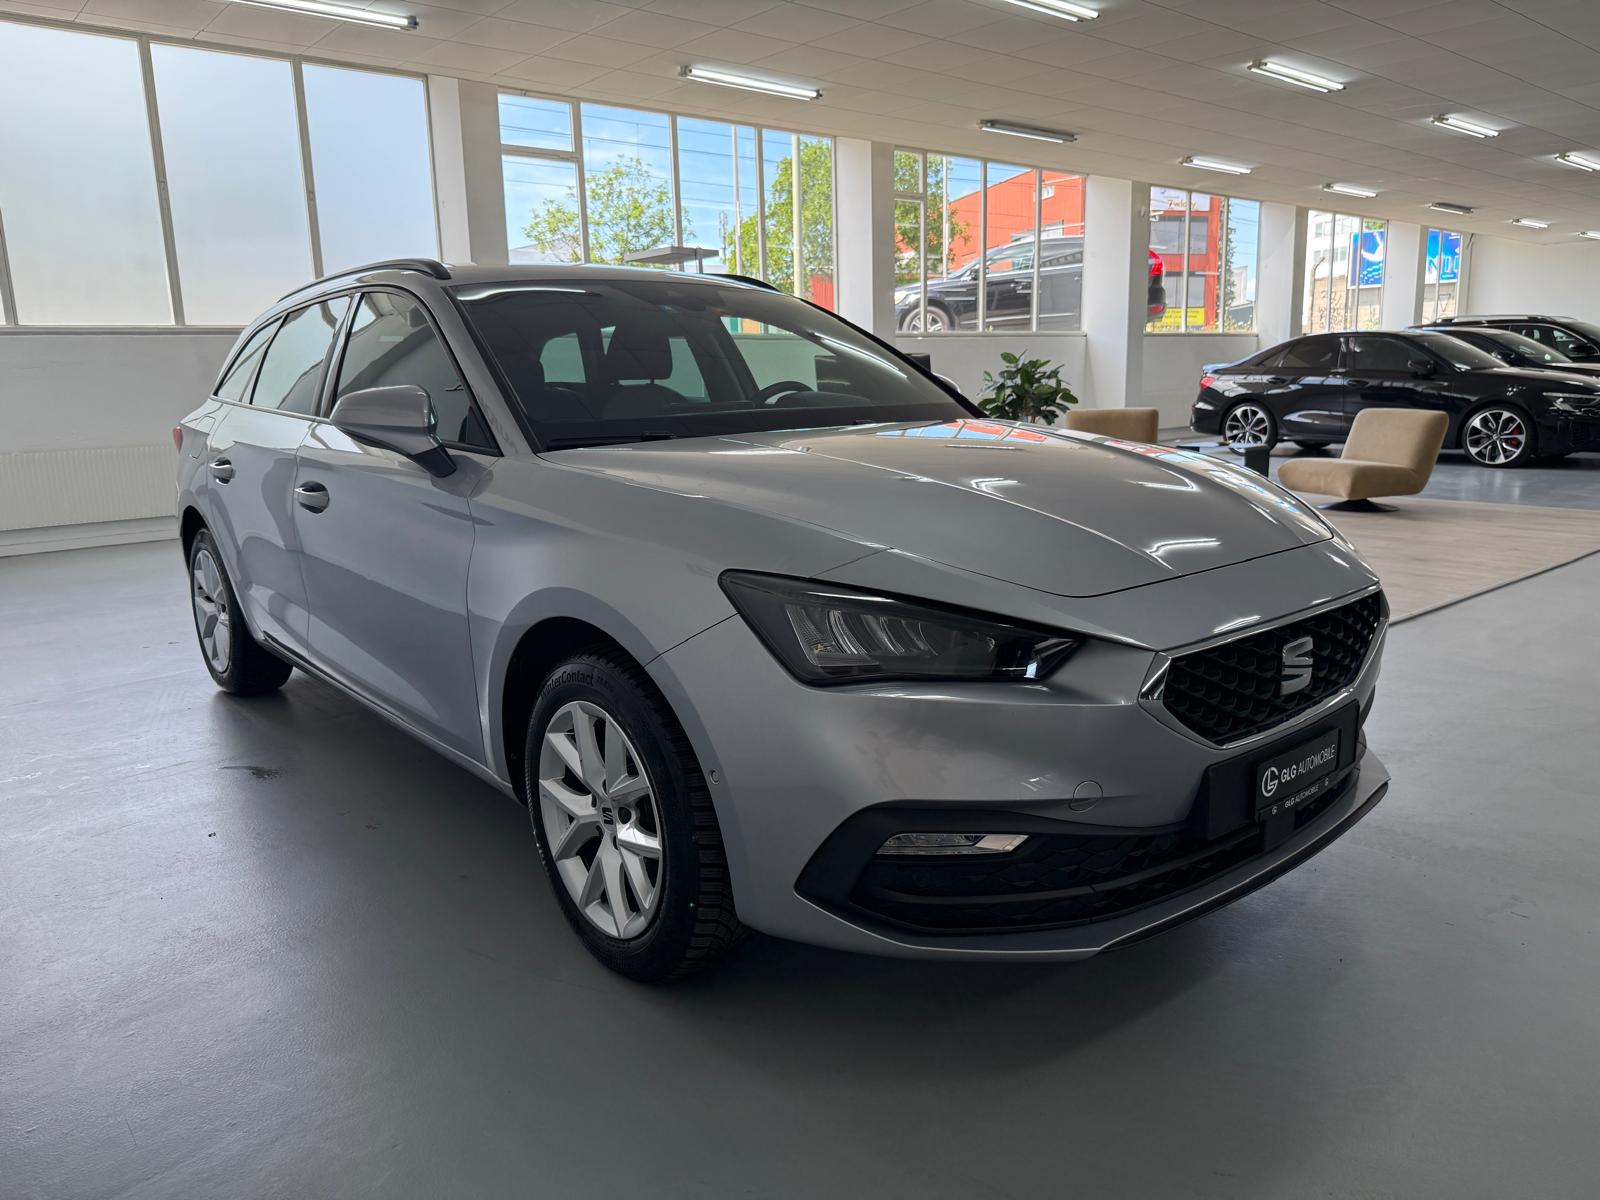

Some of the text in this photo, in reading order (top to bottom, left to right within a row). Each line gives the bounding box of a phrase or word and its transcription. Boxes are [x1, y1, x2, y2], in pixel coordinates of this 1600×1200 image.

[1281, 764, 1297, 783] GLG
[1297, 744, 1336, 776] AUTOMOBILE
[1284, 797, 1295, 808] GLG
